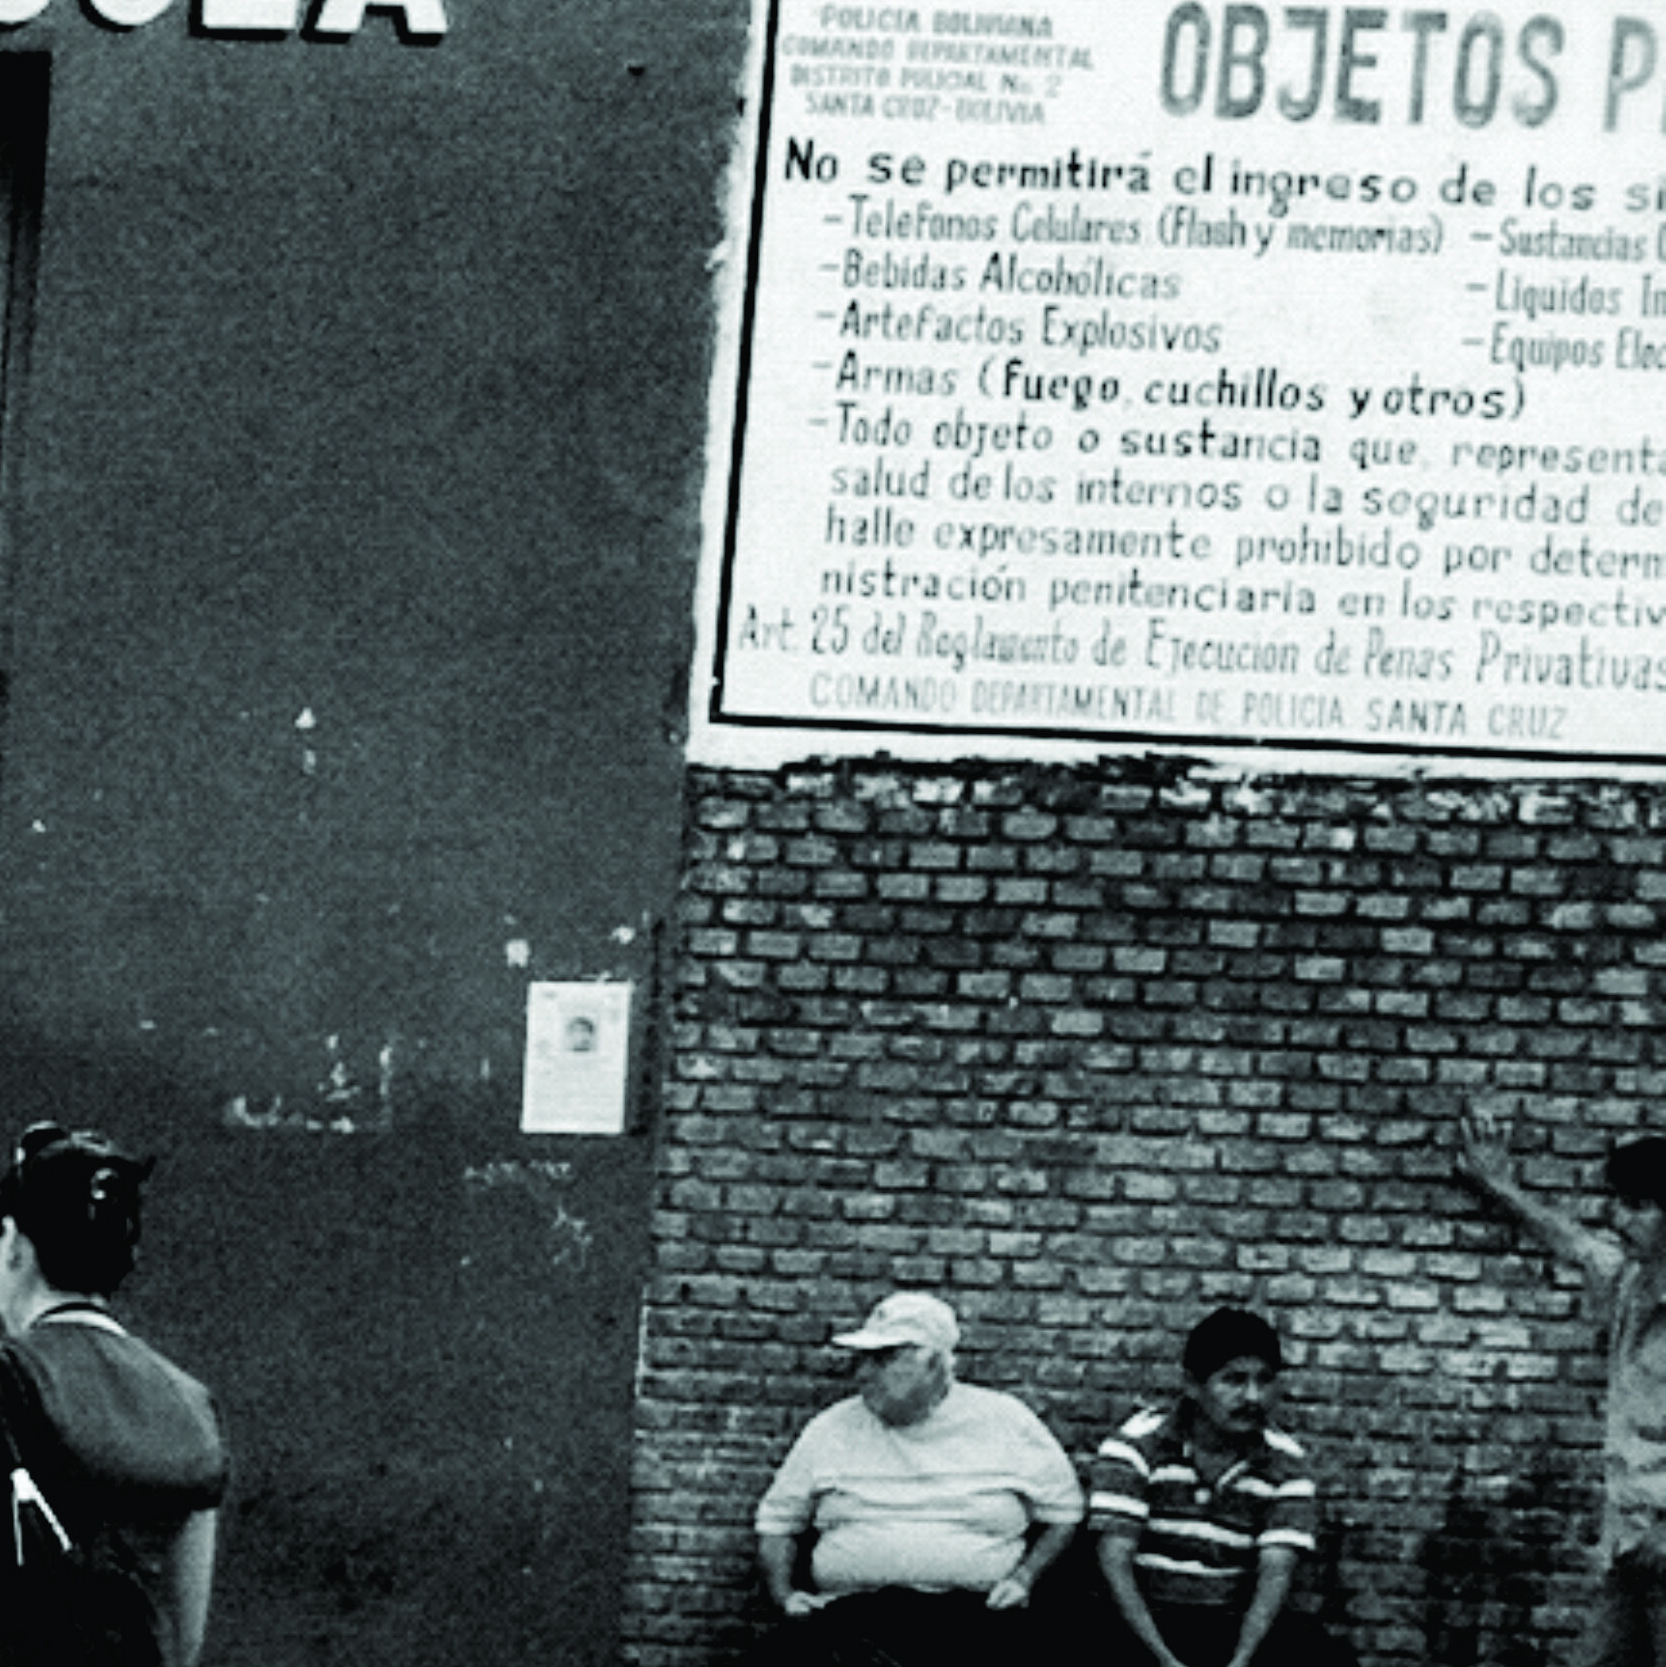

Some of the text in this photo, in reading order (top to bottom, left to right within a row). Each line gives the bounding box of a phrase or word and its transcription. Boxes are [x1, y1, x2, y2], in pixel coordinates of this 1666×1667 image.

[820, 3, 921, 33] POLICIA
[1159, 0, 1666, 135] OBJETOS P
[783, 135, 838, 185] No
[867, 151, 927, 188] se
[943, 146, 1151, 197] permitirá
[1173, 150, 1214, 196] el
[1230, 156, 1418, 219] ingreso
[1438, 160, 1497, 207] de
[1524, 163, 1596, 213] los
[1041, 303, 1224, 359] Explosivos
[1143, 366, 1327, 412] cuchillos
[1348, 387, 1372, 421] y
[1381, 370, 1526, 421] otros)
[933, 406, 1054, 459] objeto
[1078, 428, 1101, 455] o
[1120, 416, 1321, 463] sustancia
[829, 454, 1665, 532] salud de los internos o la seguridad de
[824, 501, 917, 549] halle
[931, 517, 1214, 561] expresamente
[1234, 521, 1422, 571] prohibido
[1442, 542, 1514, 579] por
[820, 556, 1028, 603] nistración
[1336, 590, 1386, 618] en
[1399, 575, 1457, 622] los
[811, 601, 852, 657] 25
[862, 609, 908, 658] del
[1091, 616, 1127, 669] de
[1313, 627, 1353, 677] de
[1364, 624, 1457, 683] Penas
[809, 670, 958, 714] COMANDO
[970, 678, 1177, 723] DEPARTAMENTAL
[1240, 690, 1344, 730] POLICIA
[1367, 693, 1467, 736] SANTA
[1486, 701, 1569, 741] CRUZ
